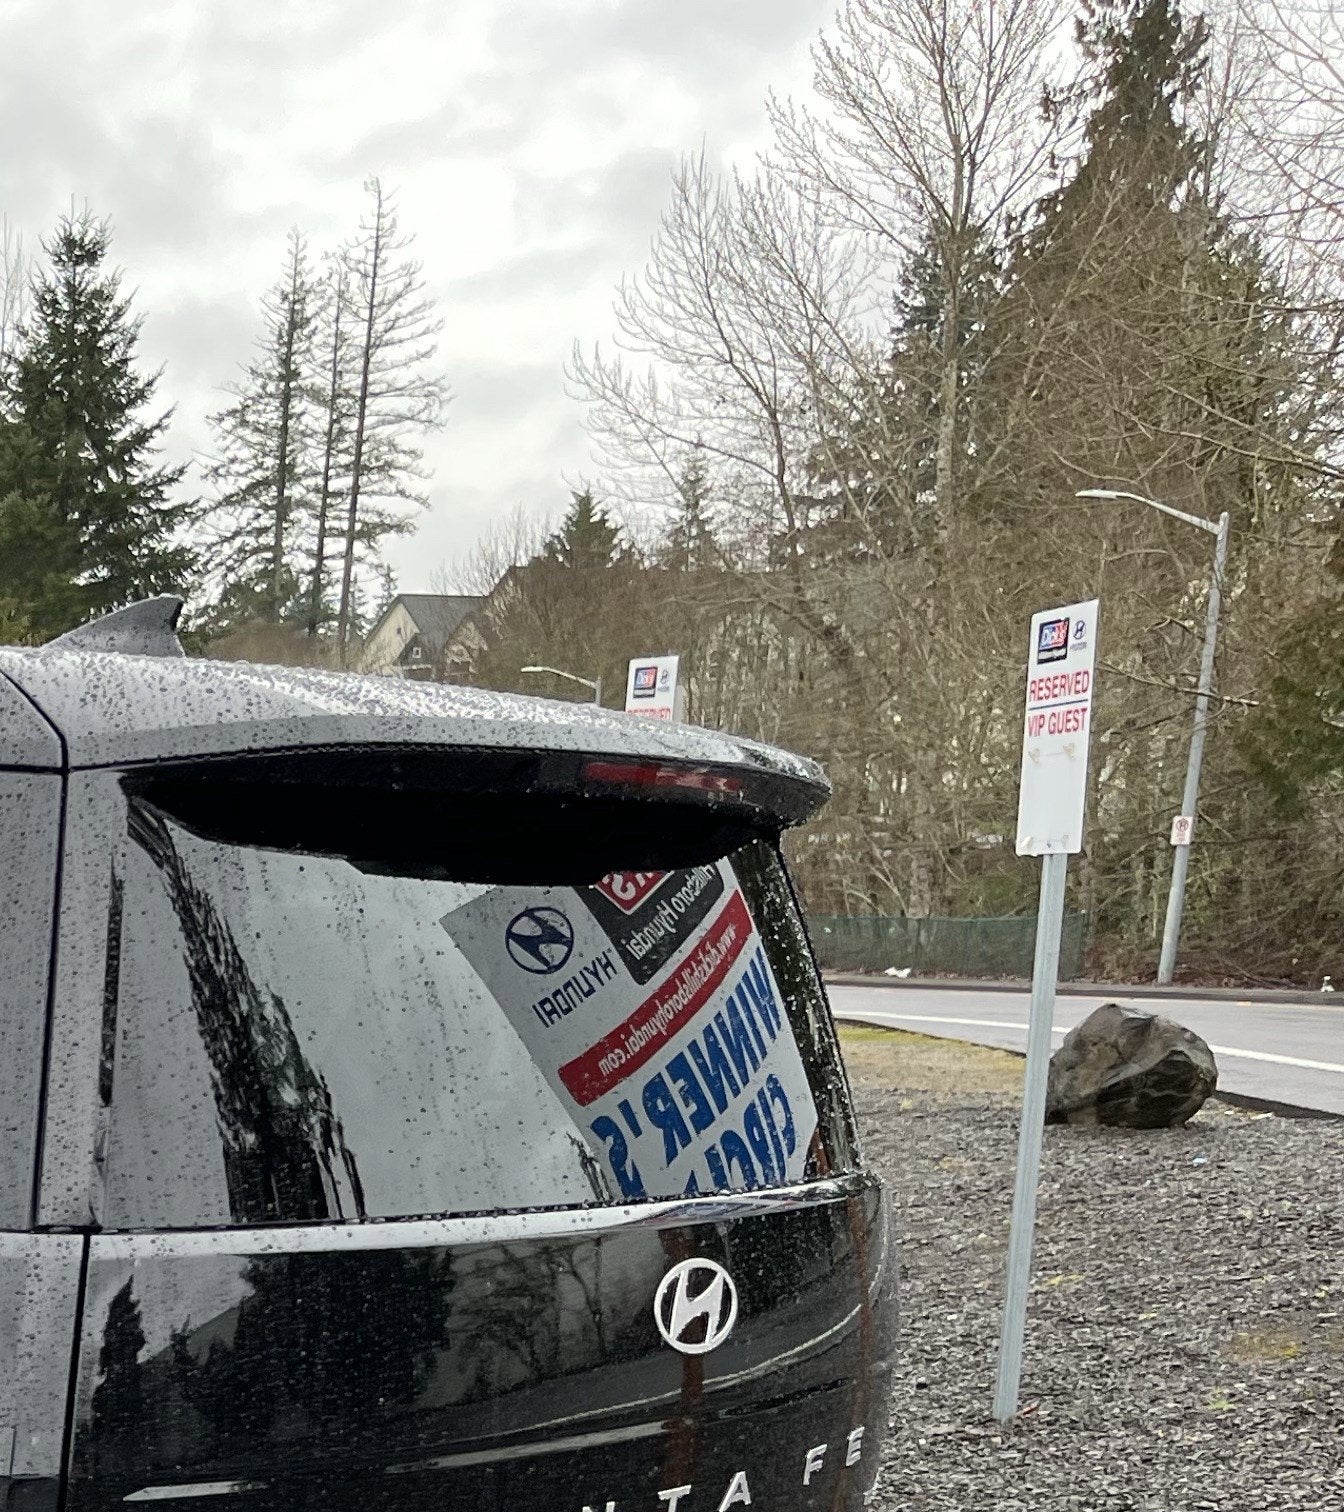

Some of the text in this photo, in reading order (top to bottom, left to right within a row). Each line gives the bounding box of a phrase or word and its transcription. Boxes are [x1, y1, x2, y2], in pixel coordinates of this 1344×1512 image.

[1029, 670, 1090, 701] RESERVED
[1027, 707, 1088, 737] VIP GUEST
[803, 1426, 866, 1486] FE
